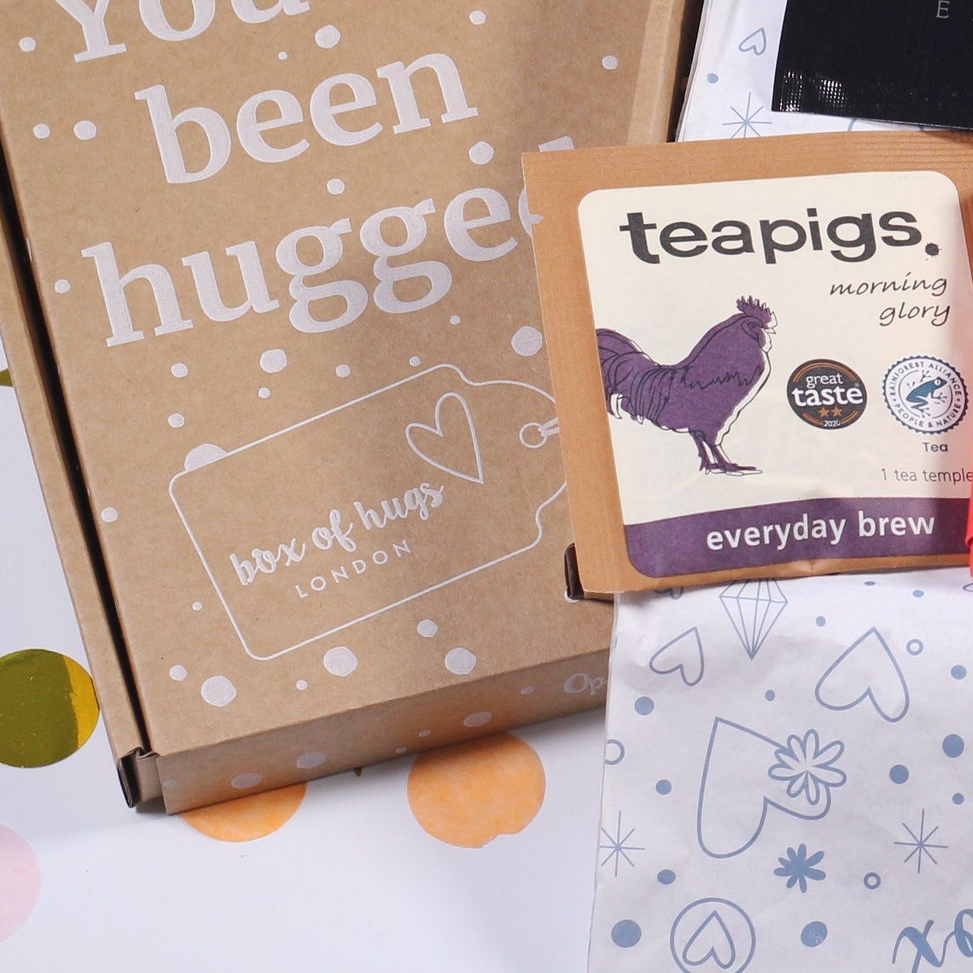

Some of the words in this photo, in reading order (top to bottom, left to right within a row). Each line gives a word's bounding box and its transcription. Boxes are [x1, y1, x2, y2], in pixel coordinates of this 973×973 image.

[134, 52, 479, 184] been
[81, 136, 574, 347] hugge
[829, 271, 948, 297] morning
[879, 301, 951, 327] glory
[806, 373, 844, 388] great
[890, 362, 925, 395] RAINFOREST
[929, 362, 962, 395] ALLIANCE
[792, 385, 863, 407] taste
[894, 404, 924, 427] PEOPLE
[936, 404, 961, 427] NATURE
[922, 442, 948, 452] Tea
[881, 467, 887, 481] 1
[894, 468, 917, 482] tea
[229, 537, 306, 586] box
[311, 509, 353, 553] of
[353, 481, 444, 530] hugs
[706, 514, 846, 552] everyday
[857, 510, 935, 538] brew
[295, 540, 411, 598] LONDON
